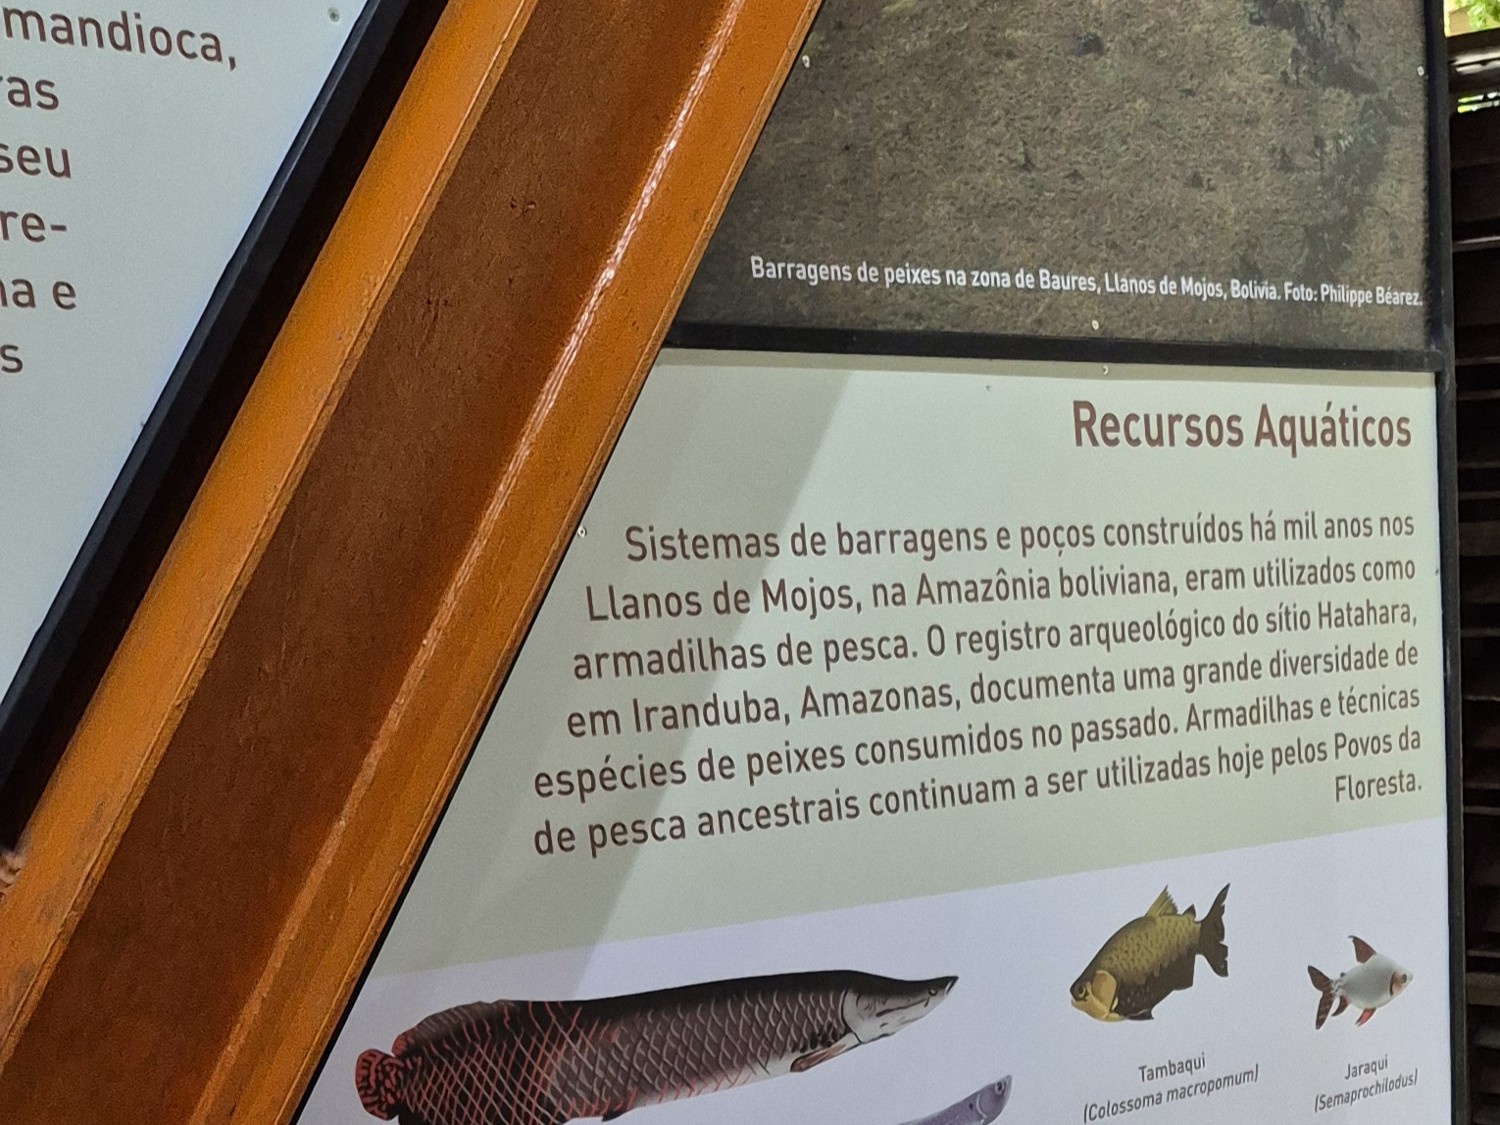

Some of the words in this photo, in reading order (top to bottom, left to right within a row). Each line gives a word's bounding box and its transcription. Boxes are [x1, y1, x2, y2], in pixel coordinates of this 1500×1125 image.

[2, 6, 237, 72] mandioca,
[52, 281, 77, 311] e
[750, 254, 853, 287] Barragens
[856, 260, 879, 283] de
[883, 261, 942, 289] peixes
[945, 269, 967, 287] na
[970, 270, 1012, 288] zona
[1014, 267, 1035, 289] de
[1038, 268, 1102, 295] Baures,
[1104, 271, 1157, 295] Llanos
[1159, 274, 1178, 296] de
[1180, 275, 1228, 302] Mojos,
[1283, 280, 1318, 302] Foto:
[1320, 282, 1373, 308] Philippe
[1072, 399, 1244, 448] Recursos
[1253, 400, 1412, 459] Aquáticos
[625, 525, 780, 562] Sistemas
[790, 522, 827, 557] de
[836, 521, 988, 562] barragens
[996, 526, 1011, 551] e
[1020, 523, 1096, 559] poços
[1103, 511, 1244, 547] construídos
[1249, 509, 1277, 542] há
[1283, 510, 1319, 541] mil
[1324, 516, 1374, 539] anos
[1379, 515, 1415, 537] nos
[585, 584, 703, 622] Llanos
[712, 579, 751, 616] de
[761, 576, 863, 621] Mojos,
[871, 582, 907, 609] na
[916, 567, 1051, 606] Amazônia
[1057, 565, 1178, 599] boliviana,
[1185, 567, 1246, 592] eram
[1252, 555, 1356, 590] utilizados
[1362, 559, 1416, 582] como
[573, 636, 767, 681] armadilhas
[776, 632, 813, 667] de
[823, 634, 918, 674] pesca.
[926, 623, 946, 657] O
[955, 619, 1061, 662] registro
[1069, 607, 1226, 653] arqueológico
[1232, 605, 1259, 636] do
[1265, 601, 1311, 635] sítio
[1317, 598, 1417, 631] Hatahara,
[567, 709, 622, 739] em
[632, 689, 791, 733] Iranduba,
[800, 683, 961, 720] Amazonas,
[969, 665, 1116, 705] documenta
[1123, 665, 1176, 692] uma
[1182, 651, 1263, 694] grande
[1269, 641, 1389, 681] diversidade
[1395, 639, 1419, 667] de
[534, 753, 687, 805] espécies
[697, 747, 736, 783] de
[746, 739, 846, 787] peixes
[854, 721, 1024, 767] consumidos
[1031, 723, 1063, 749] no
[1070, 706, 1179, 753] passado.
[1185, 693, 1314, 733] Armadilhas
[1319, 697, 1332, 718] e
[1337, 684, 1420, 716] técnicas
[533, 818, 576, 856] de
[588, 815, 686, 859] pesca
[697, 787, 861, 837] ancestrais
[869, 777, 1016, 817] continuam
[1024, 774, 1039, 798] a
[1047, 768, 1089, 796] ser
[1096, 749, 1211, 789] utilizadas
[1217, 742, 1265, 780] hoje
[1270, 736, 1328, 776] pelos
[1334, 731, 1393, 760] Povos
[1398, 724, 1421, 752] da
[1334, 769, 1422, 803] Floresta.
[1083, 1091, 1163, 1125] (Colossoma
[1166, 1062, 1259, 1103] macropomum)
[1137, 1051, 1206, 1083] Tambaqui
[1343, 1054, 1389, 1081] Jaraqui
